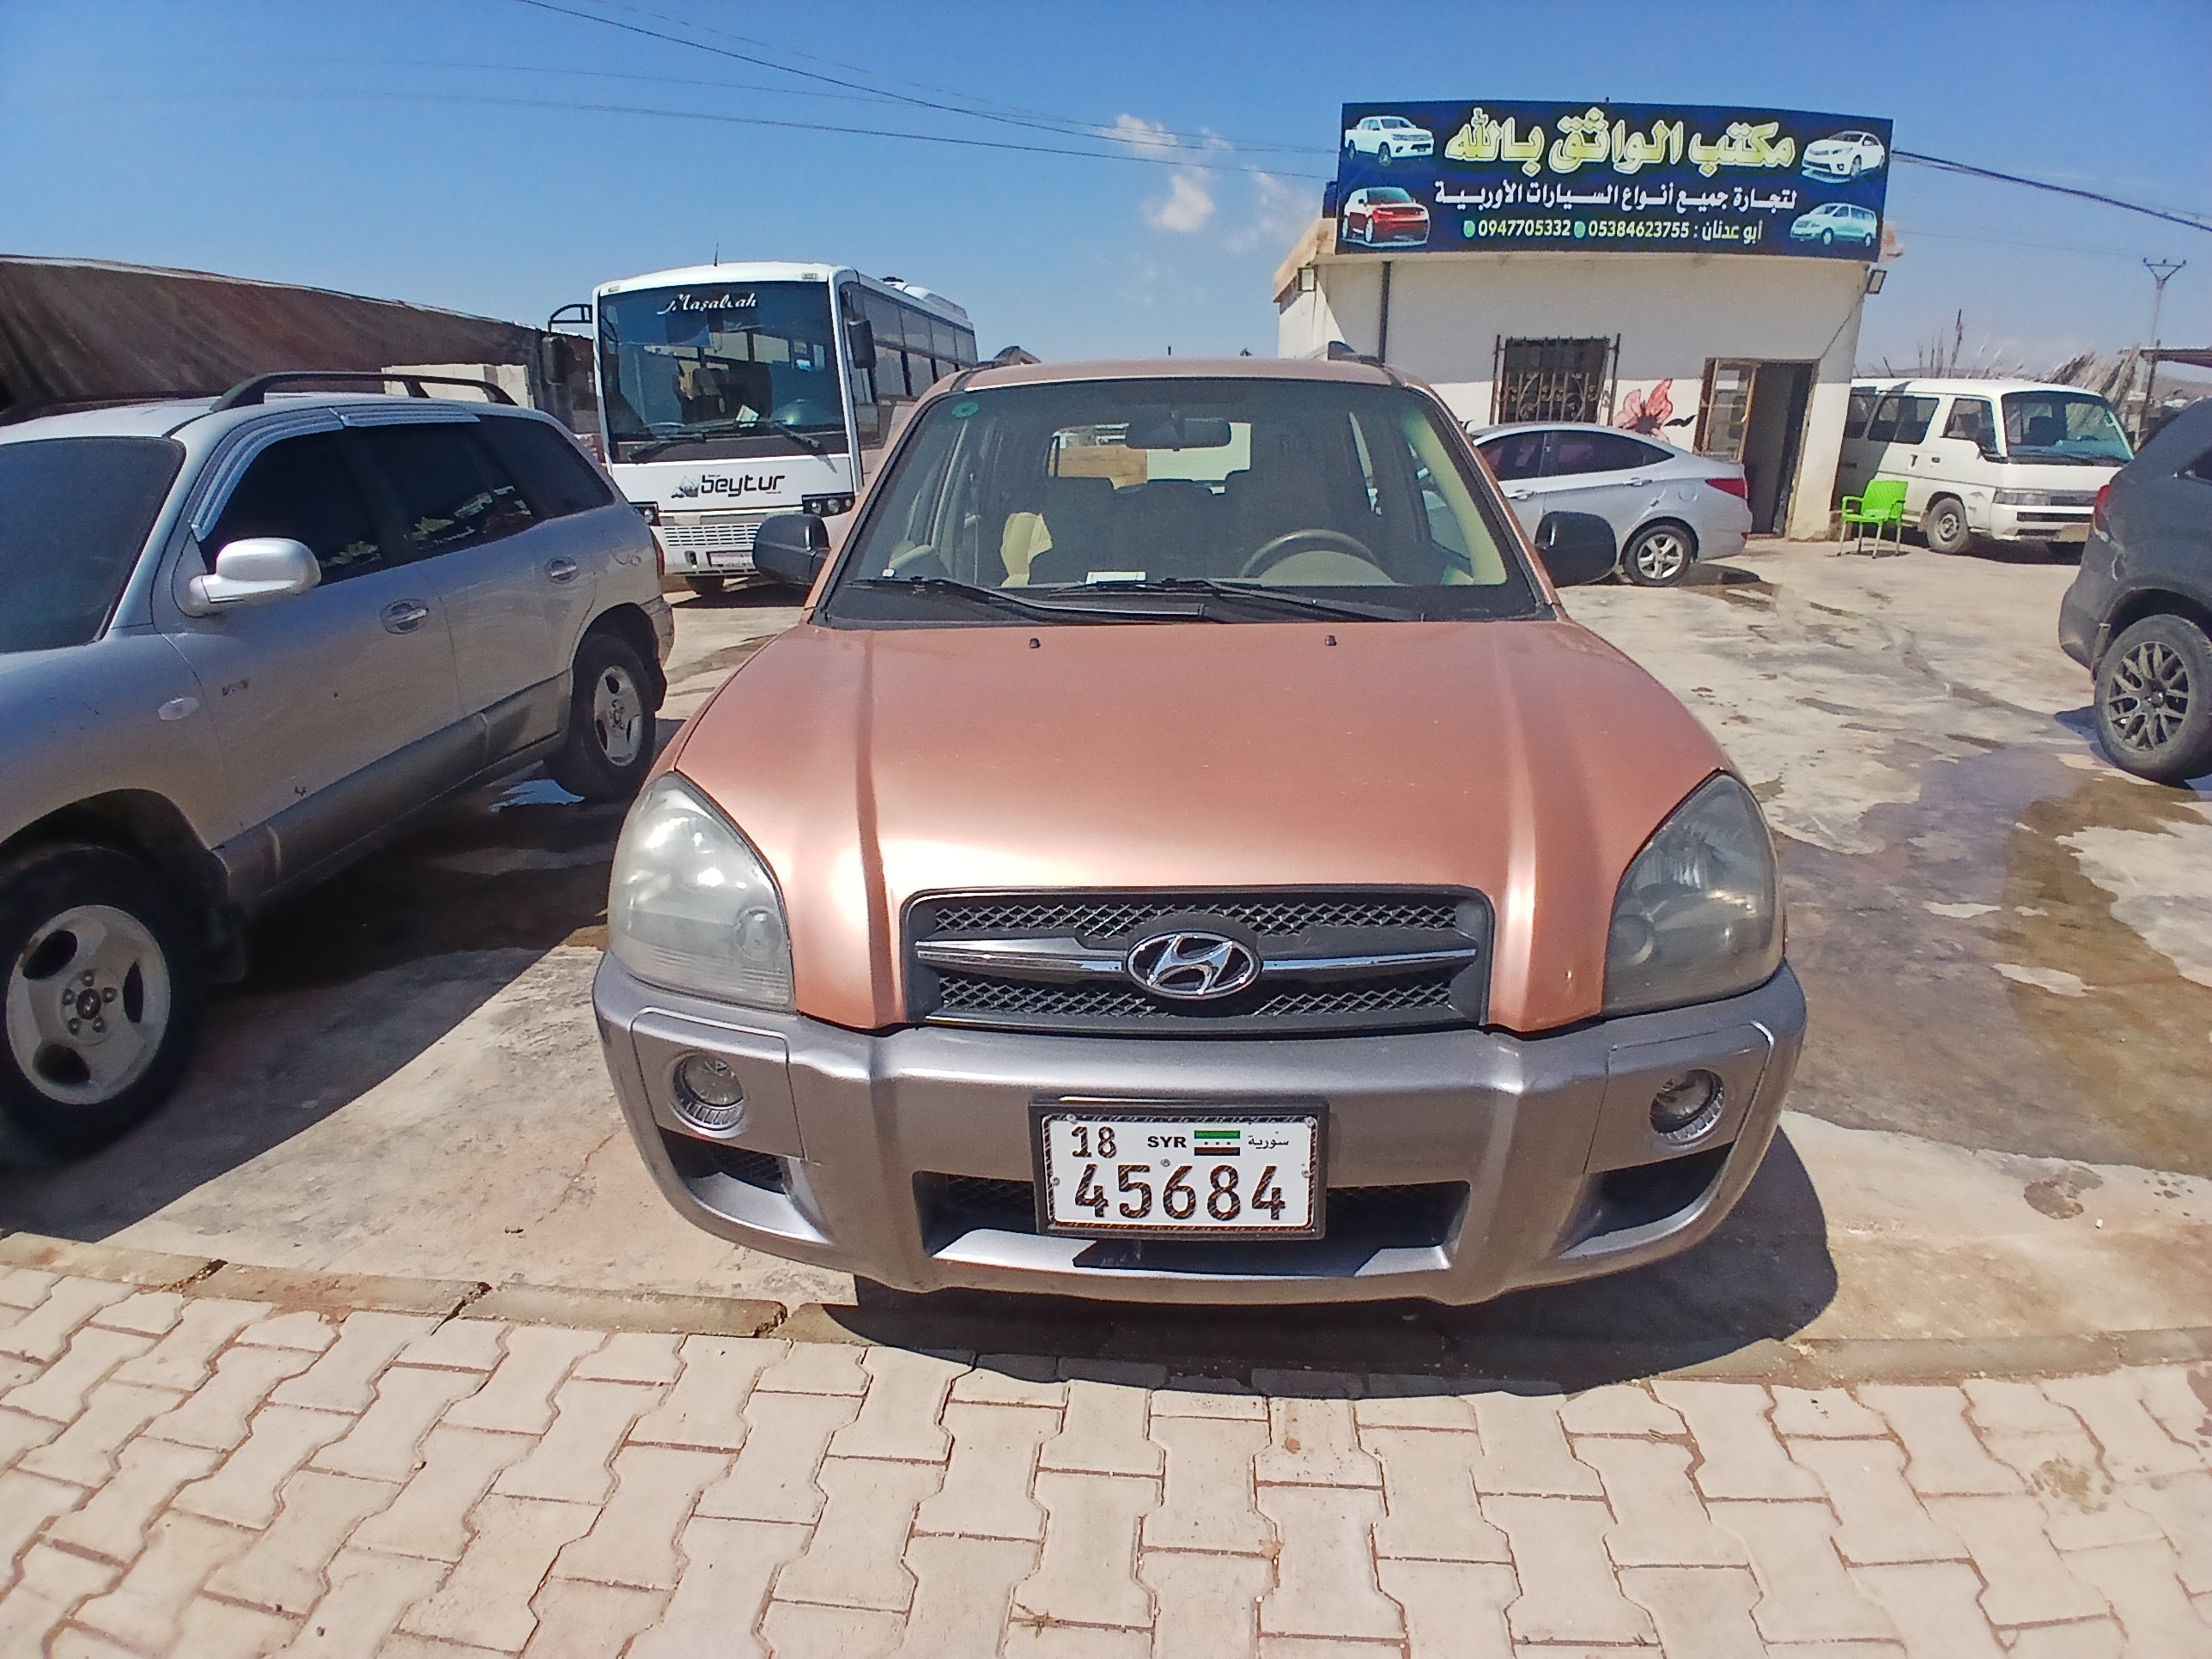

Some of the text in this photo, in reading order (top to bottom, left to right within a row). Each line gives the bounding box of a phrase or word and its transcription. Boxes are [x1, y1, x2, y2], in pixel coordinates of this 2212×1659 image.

[1444, 106, 1796, 178] مكتب الواثق بالله
[1435, 179, 1797, 214] لتجارة جميع أنواع السيارات الأوربية
[1478, 219, 1571, 237] 0947705332
[1589, 220, 1690, 239] 05384623755
[1701, 220, 1740, 241] عدنان
[1743, 218, 1763, 244] أبو
[701, 474, 786, 498] beytur
[1071, 1126, 1117, 1158] 18
[1147, 1135, 1187, 1149] SYR
[1248, 1134, 1289, 1150] سورية
[1074, 1164, 1286, 1221] 45684
